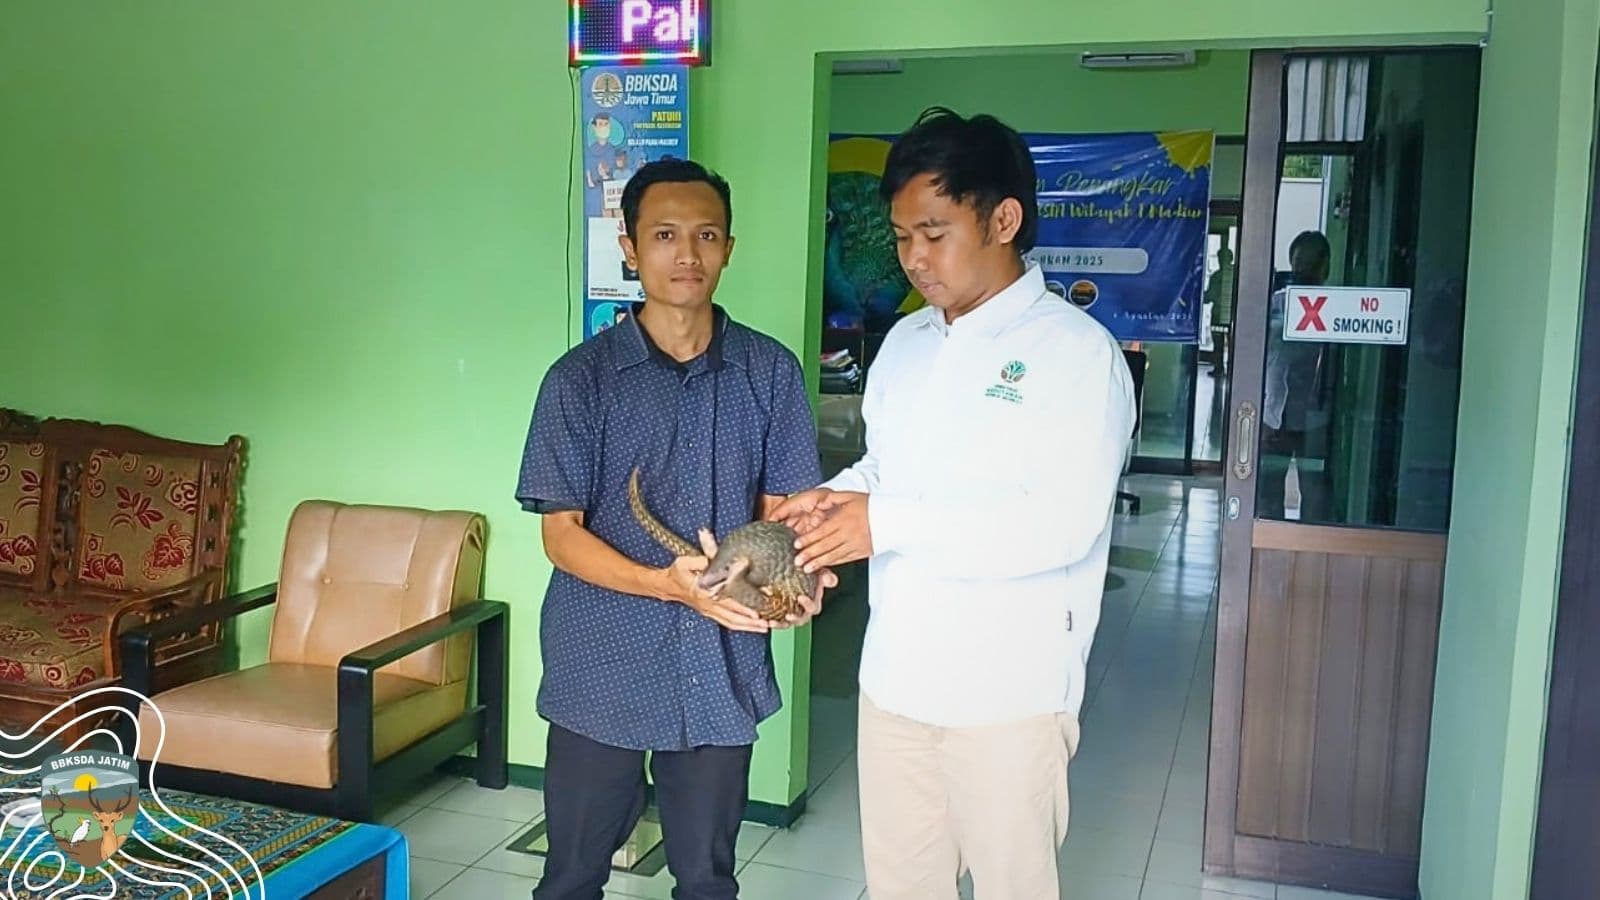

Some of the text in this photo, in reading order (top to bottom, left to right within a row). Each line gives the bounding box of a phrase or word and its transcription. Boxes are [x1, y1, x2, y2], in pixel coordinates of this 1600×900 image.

[625, 74, 678, 92] BBKSDA
[624, 92, 677, 106] Jawa Timur
[1075, 254, 1104, 266] 2025
[1360, 297, 1379, 312] NO
[1333, 317, 1393, 334] SMOKING
